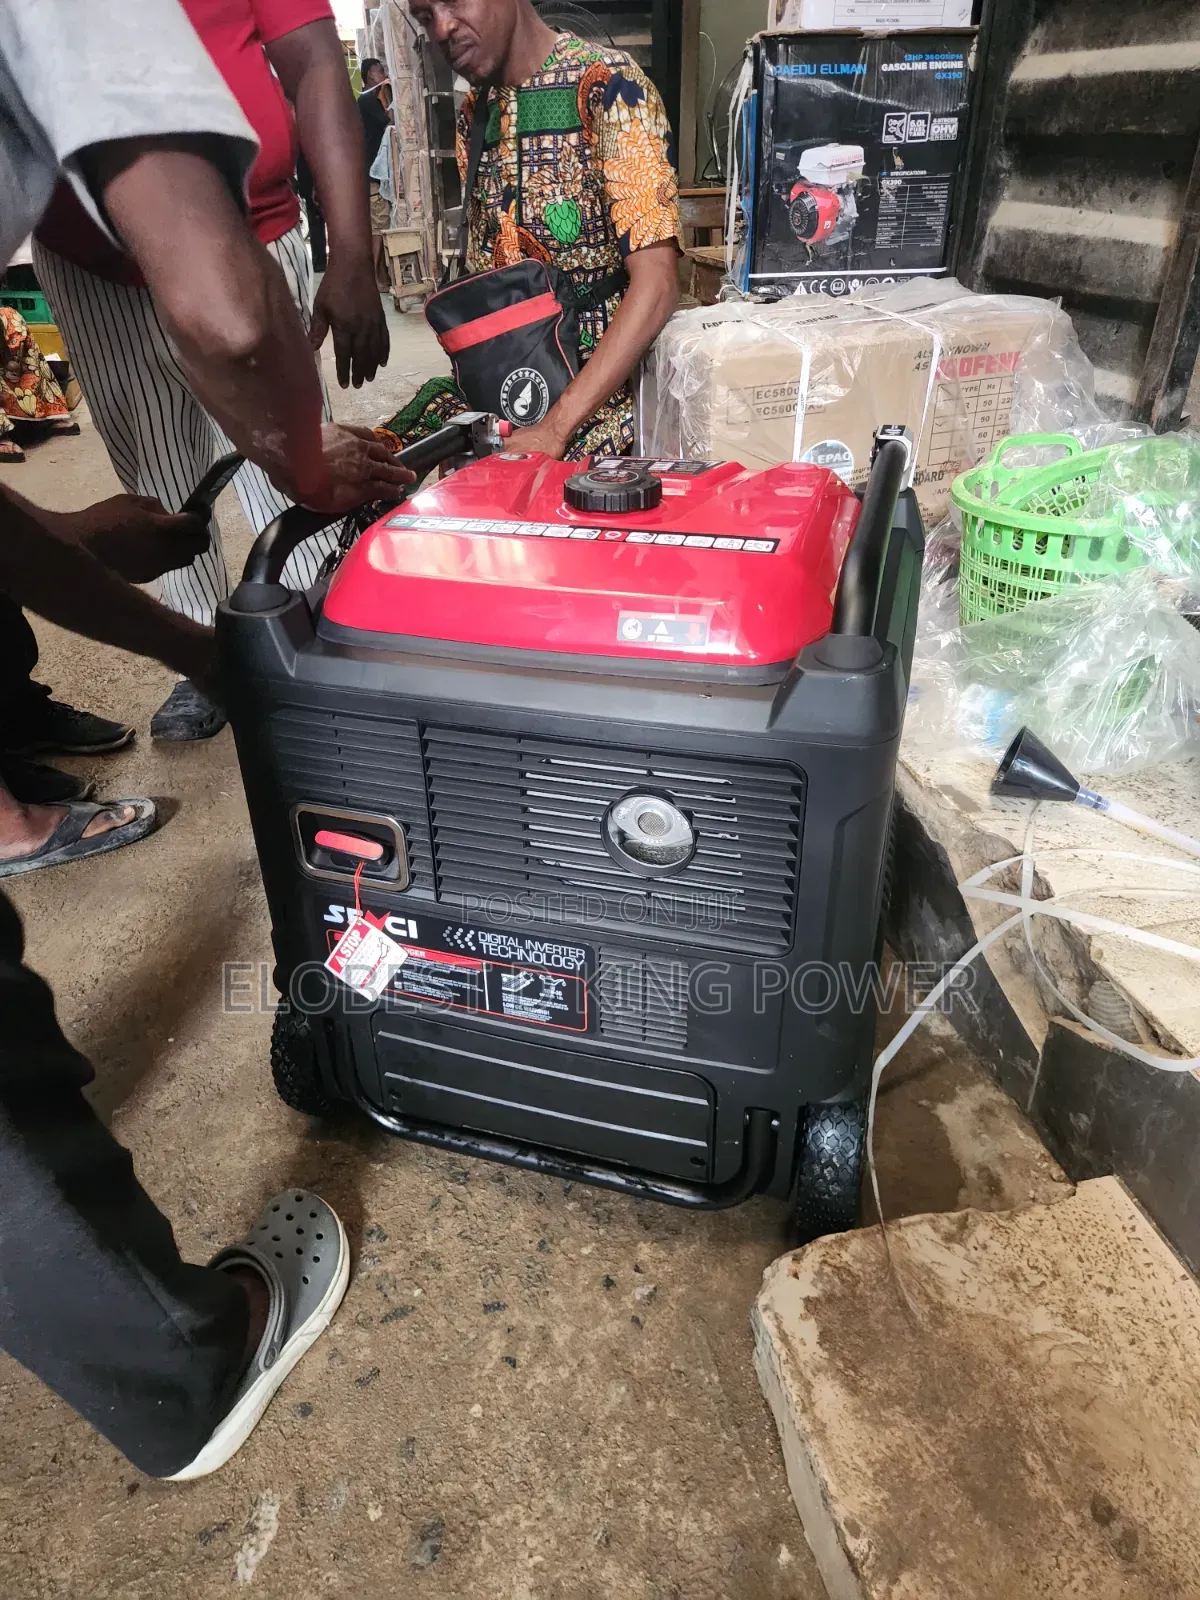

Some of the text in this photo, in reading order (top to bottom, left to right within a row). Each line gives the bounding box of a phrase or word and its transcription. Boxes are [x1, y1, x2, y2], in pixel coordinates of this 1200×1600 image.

[820, 63, 867, 75] ELLMAN
[881, 61, 964, 71] GASOLINE ENGINE
[932, 124, 956, 133] OHV
[912, 361, 929, 372] AS
[980, 415, 991, 423] 50
[340, 929, 361, 958] STOP
[478, 931, 586, 960] DIGITAL INVERTER
[479, 942, 585, 971] TECHNOLOGY
